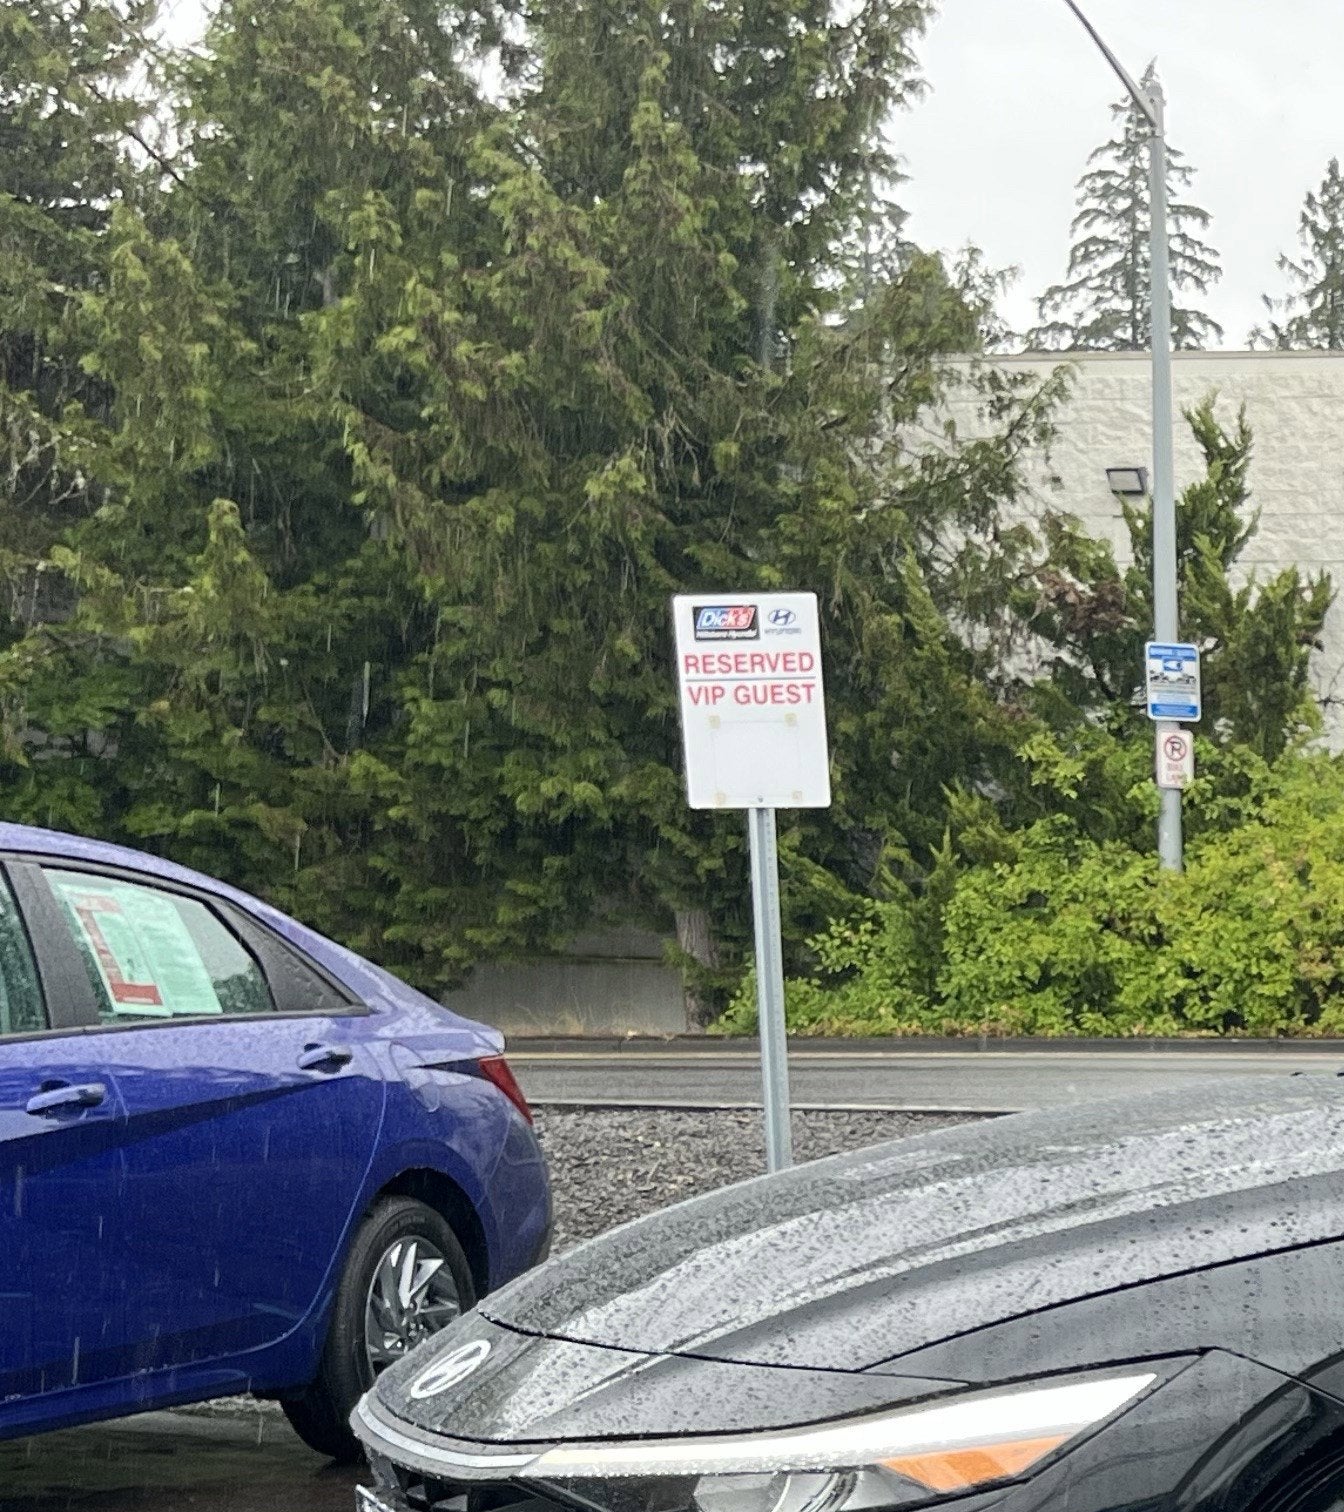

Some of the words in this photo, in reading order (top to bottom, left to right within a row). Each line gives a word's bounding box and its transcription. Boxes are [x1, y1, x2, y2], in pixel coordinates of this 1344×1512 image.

[684, 652, 814, 674] RESERVED
[687, 685, 725, 705] VIP
[734, 684, 815, 705] GUEST
